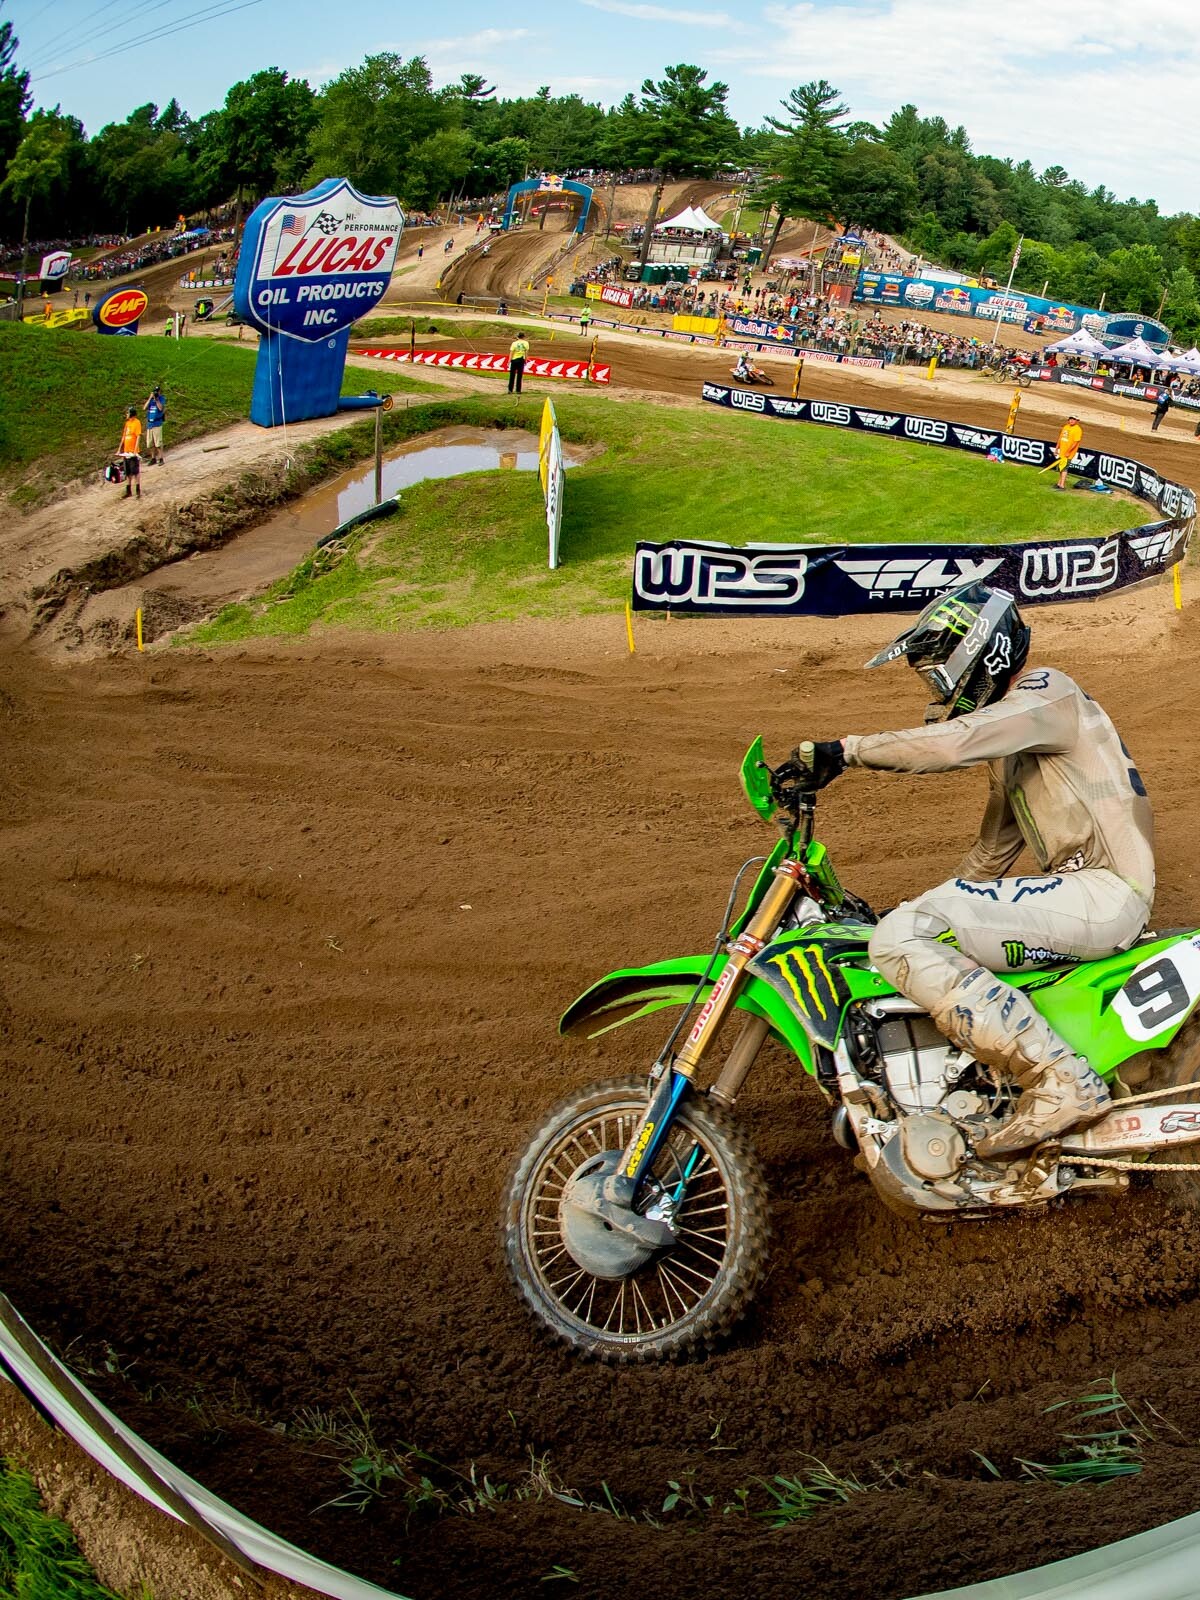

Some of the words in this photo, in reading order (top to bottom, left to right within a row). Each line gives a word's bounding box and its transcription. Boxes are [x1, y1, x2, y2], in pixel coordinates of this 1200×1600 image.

[344, 224, 399, 232] PERFORMANCE
[272, 236, 394, 277] LUCAS
[258, 287, 290, 306] OIL
[297, 281, 385, 303] PRODUCTS
[602, 288, 620, 304] LUCAS
[620, 293, 630, 306] OIL
[103, 297, 145, 318] FMF
[303, 308, 338, 326] INC.
[734, 320, 750, 333] Red
[750, 322, 767, 336] Bull
[731, 390, 765, 412] WPS
[768, 399, 807, 413] FLY
[810, 402, 851, 425] WPS
[855, 411, 901, 427] FLY
[863, 422, 891, 430] RACING
[904, 416, 948, 443] WPS
[951, 427, 998, 446] FLY
[960, 440, 987, 450] RACING
[1002, 435, 1045, 464] WPS
[1098, 454, 1137, 489] WPS
[636, 547, 808, 605] WPS
[833, 558, 1006, 590] FLY
[1019, 539, 1119, 597] WPS
[869, 587, 950, 599] RACIN
[887, 640, 909, 661] FOX
[1122, 957, 1191, 1030] 9
